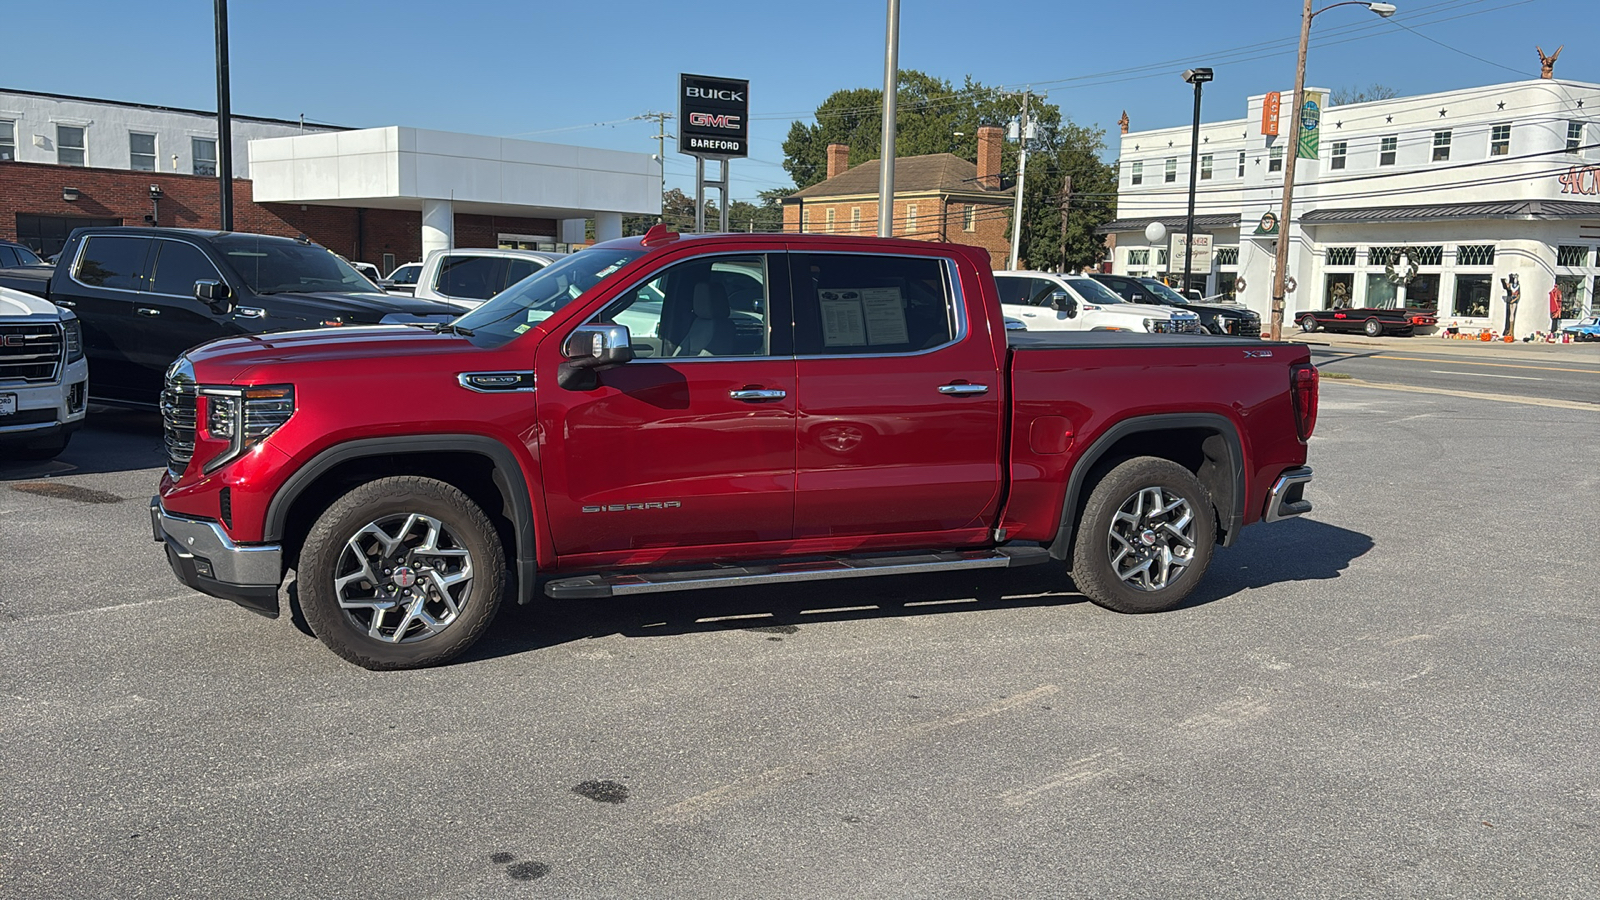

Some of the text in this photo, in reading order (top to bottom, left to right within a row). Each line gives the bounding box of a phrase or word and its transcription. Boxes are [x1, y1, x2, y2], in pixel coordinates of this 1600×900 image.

[686, 87, 744, 102] BUICK
[690, 112, 741, 129] GMC
[1269, 94, 1278, 132] ACME
[690, 138, 740, 151] BAREFORD
[581, 500, 682, 513] SIERRA
